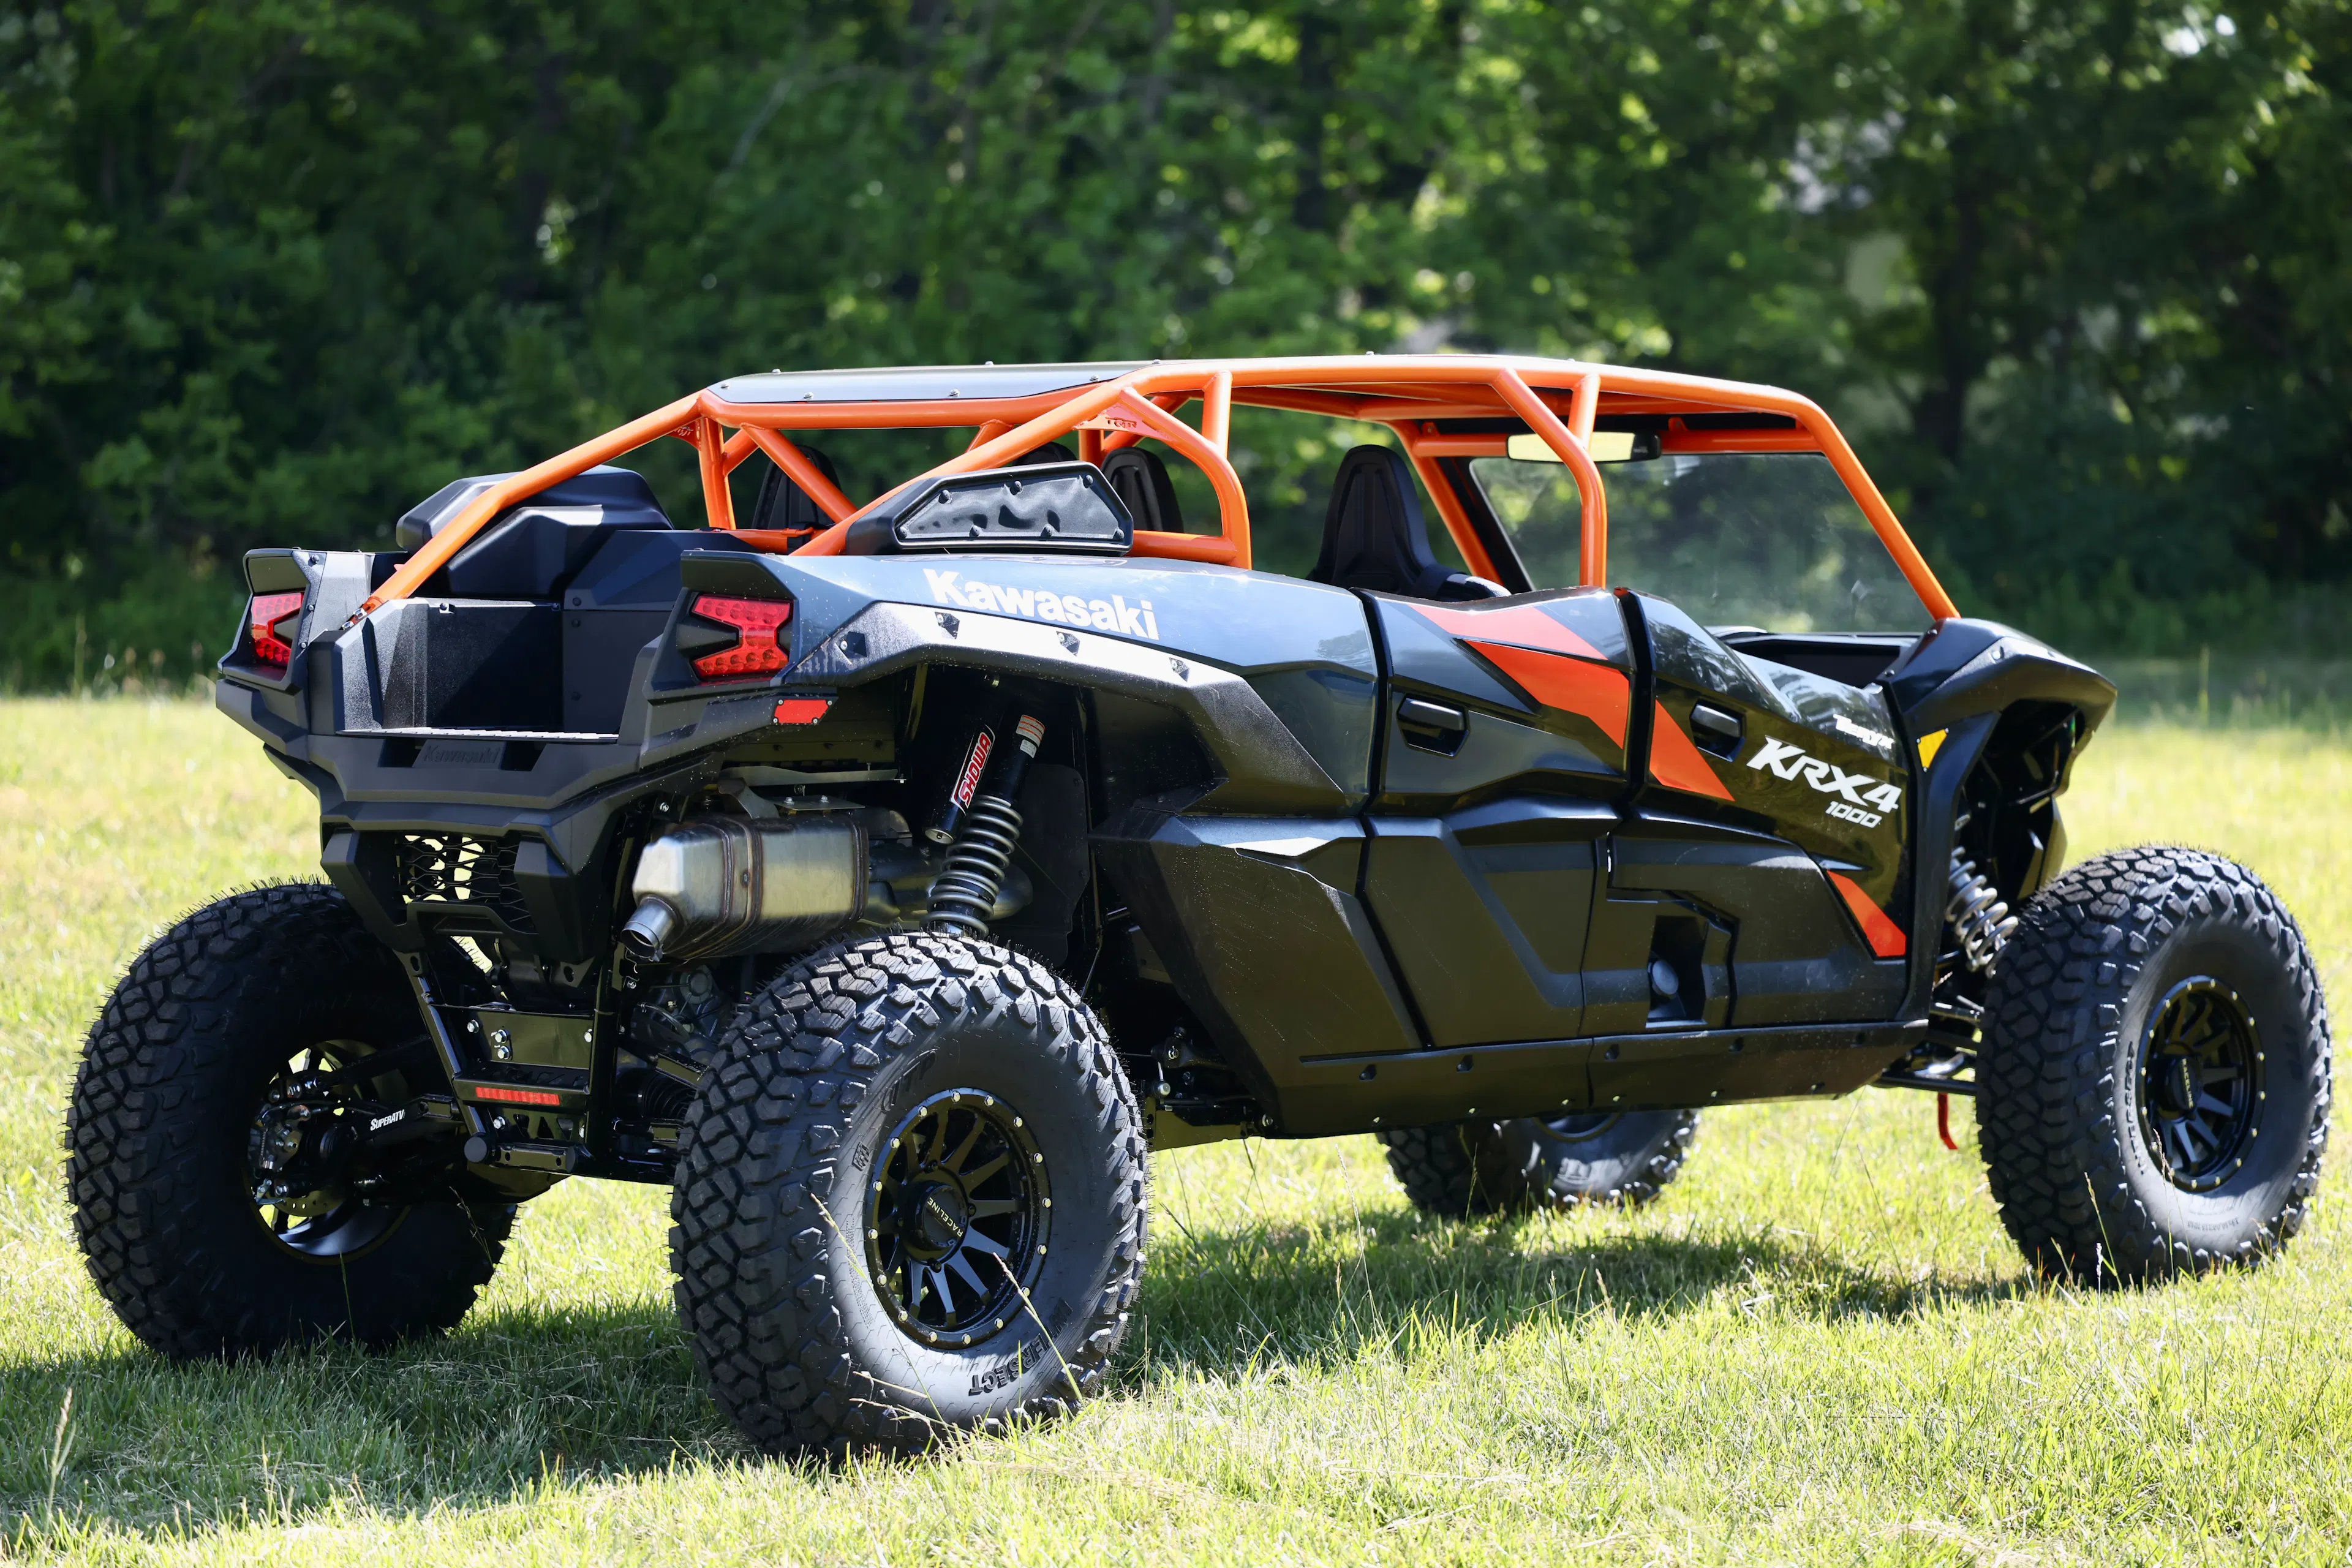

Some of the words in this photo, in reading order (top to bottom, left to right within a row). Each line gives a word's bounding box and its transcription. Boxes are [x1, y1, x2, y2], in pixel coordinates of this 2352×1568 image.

[922, 568, 1159, 641] Kawasaki
[424, 745, 501, 764] Kawasaki
[959, 732, 992, 809] SHOWA
[1746, 734, 1902, 813] KRX4
[1825, 801, 1882, 828] 1000
[927, 1197, 963, 1237] RACELINE
